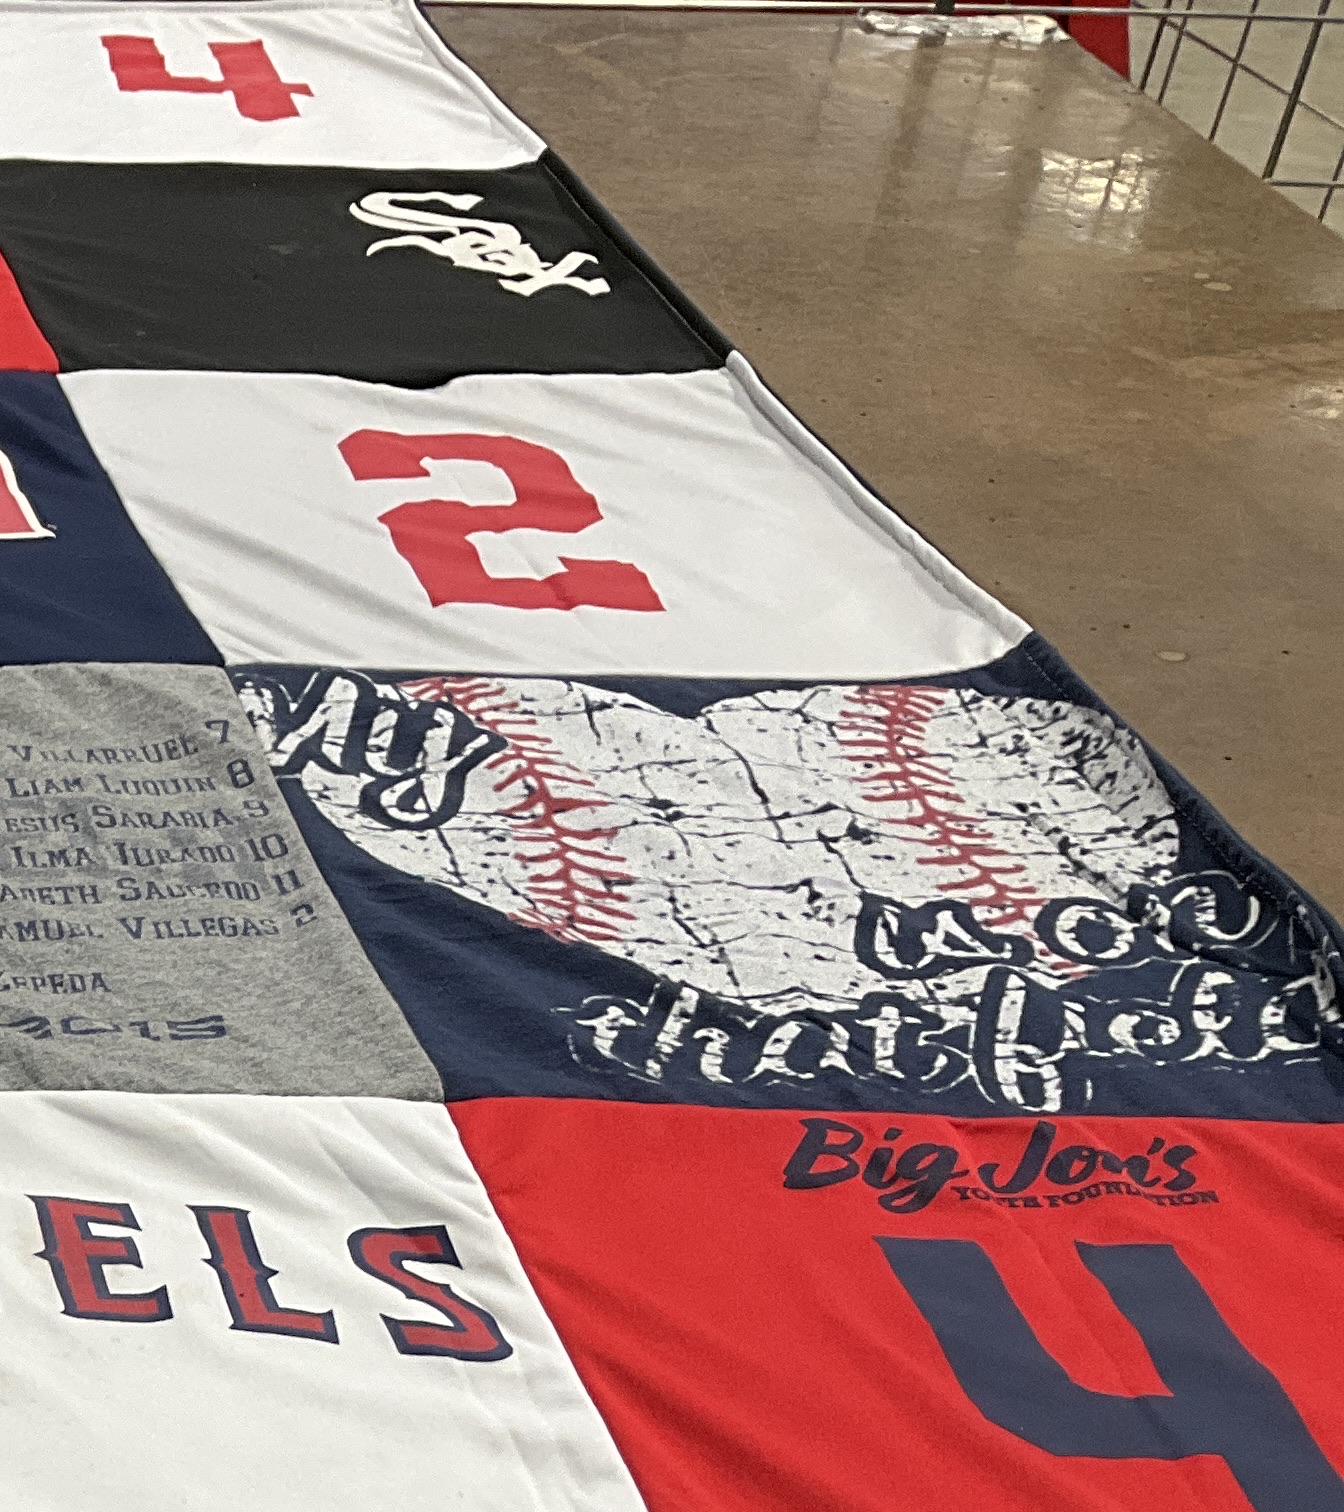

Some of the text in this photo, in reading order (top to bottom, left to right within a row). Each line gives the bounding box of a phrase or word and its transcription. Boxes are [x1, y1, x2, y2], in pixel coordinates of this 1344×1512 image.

[99, 35, 313, 121] 4
[337, 429, 665, 611] 2
[205, 719, 231, 745] 7
[5, 775, 84, 798] LIAM
[226, 759, 255, 789] 8
[242, 800, 269, 818] 9
[243, 832, 289, 863] 10
[116, 915, 280, 940] VILLEGAS
[783, 1117, 1199, 1214] Big Jon's
[950, 1181, 1220, 1208] YOTH FOUNTION
